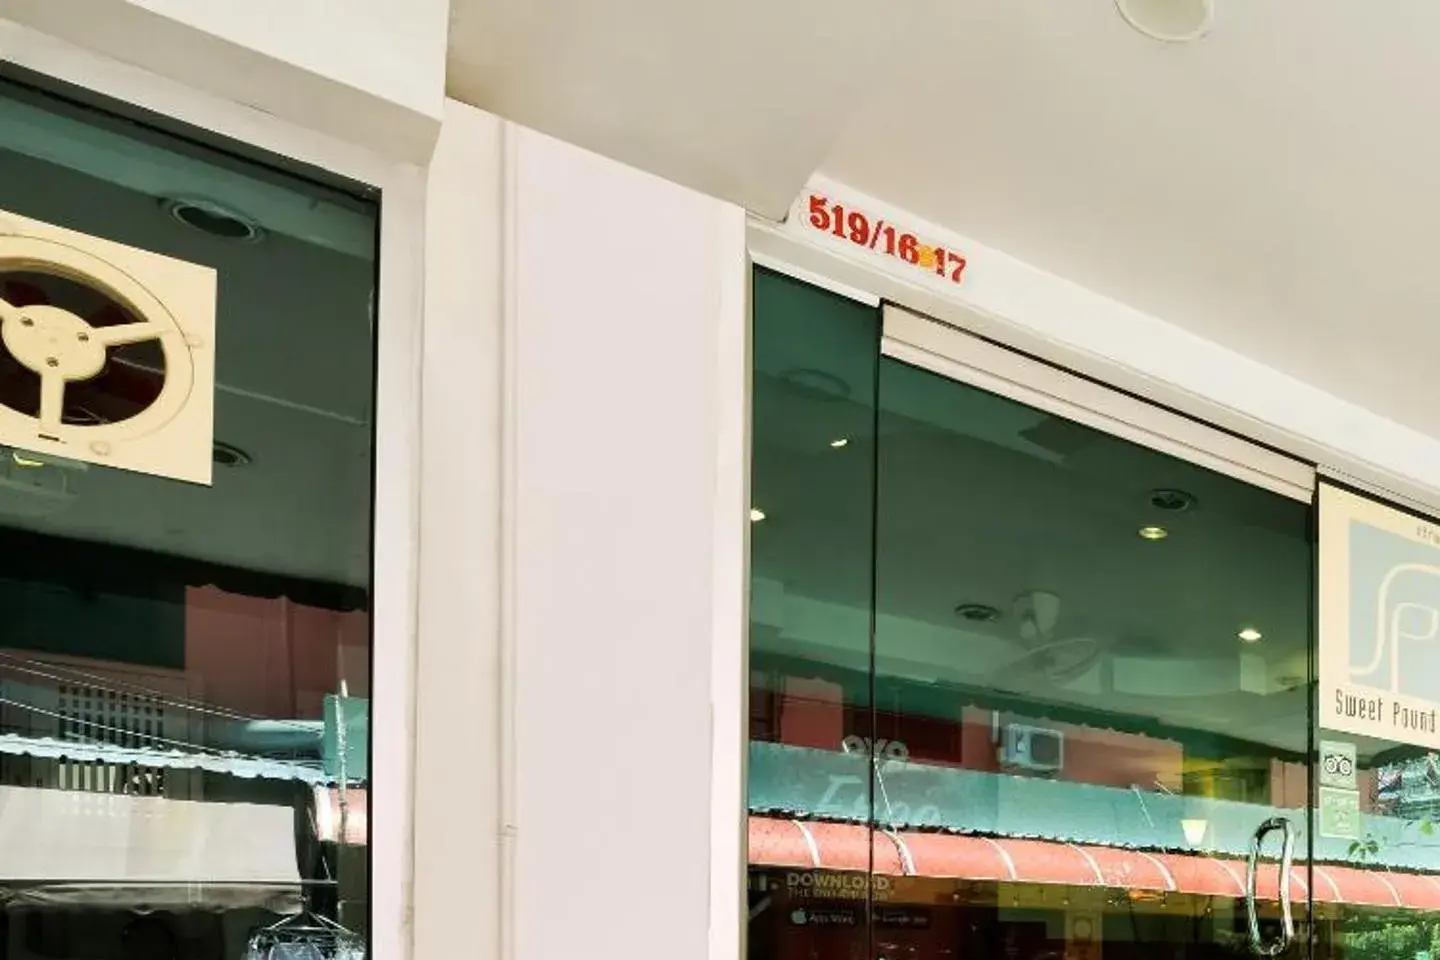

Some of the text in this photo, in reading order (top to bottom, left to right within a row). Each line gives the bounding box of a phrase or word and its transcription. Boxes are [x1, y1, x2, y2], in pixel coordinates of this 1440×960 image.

[1335, 689, 1383, 722] Sweet
[1393, 702, 1436, 733] Pound
[787, 872, 890, 891] DOWNLOAD
